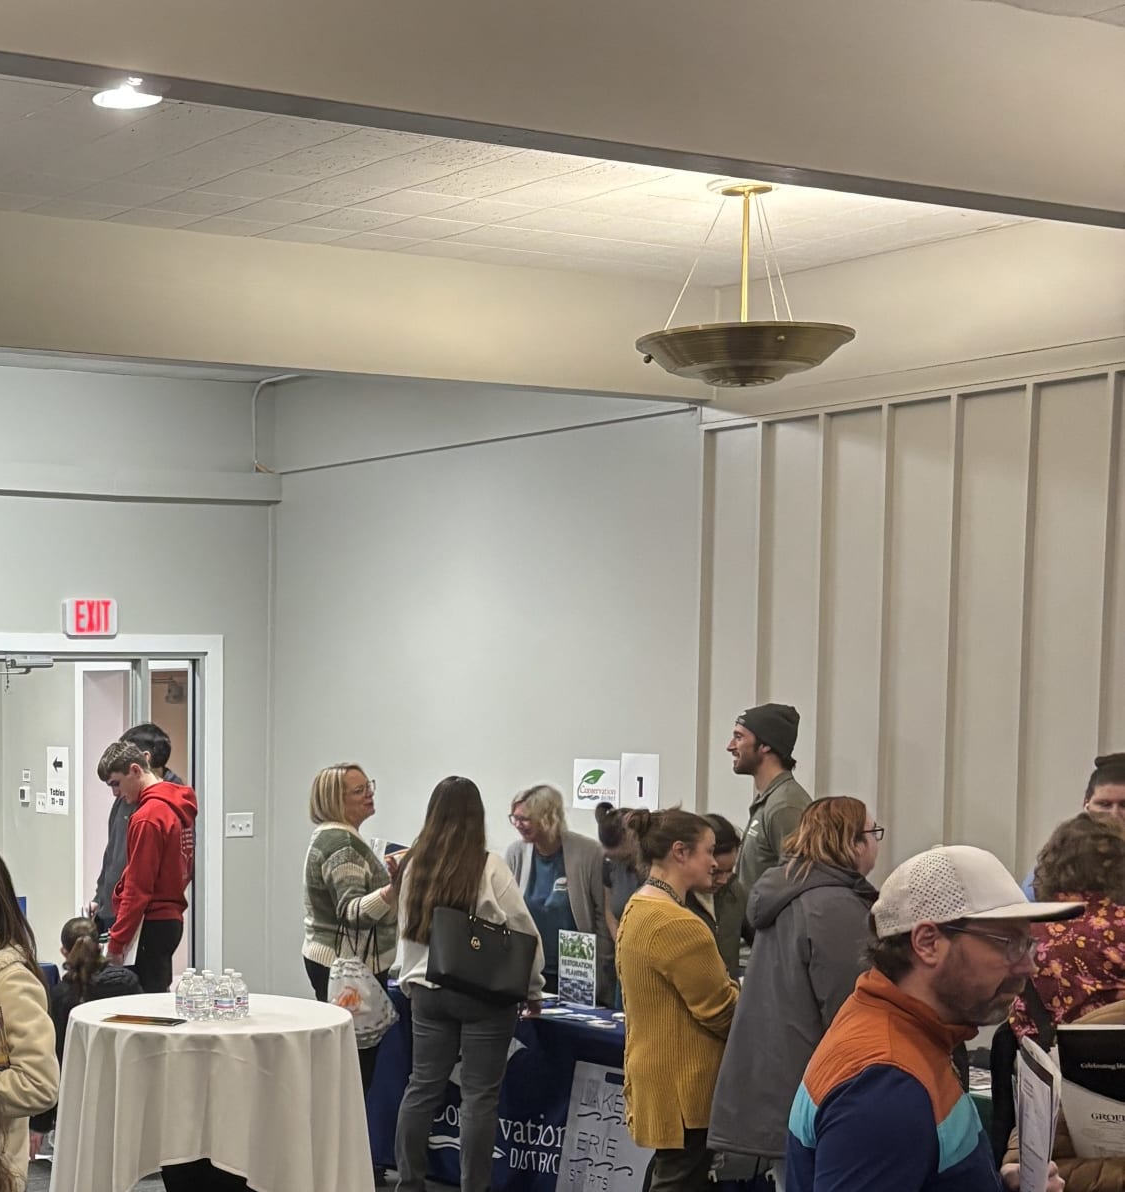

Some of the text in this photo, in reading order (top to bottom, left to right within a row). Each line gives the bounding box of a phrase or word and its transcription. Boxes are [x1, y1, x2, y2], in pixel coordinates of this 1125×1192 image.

[75, 600, 111, 633] EXIT
[49, 788, 65, 797] Tables
[636, 776, 644, 797] 1
[576, 1131, 619, 1158] ERIE
